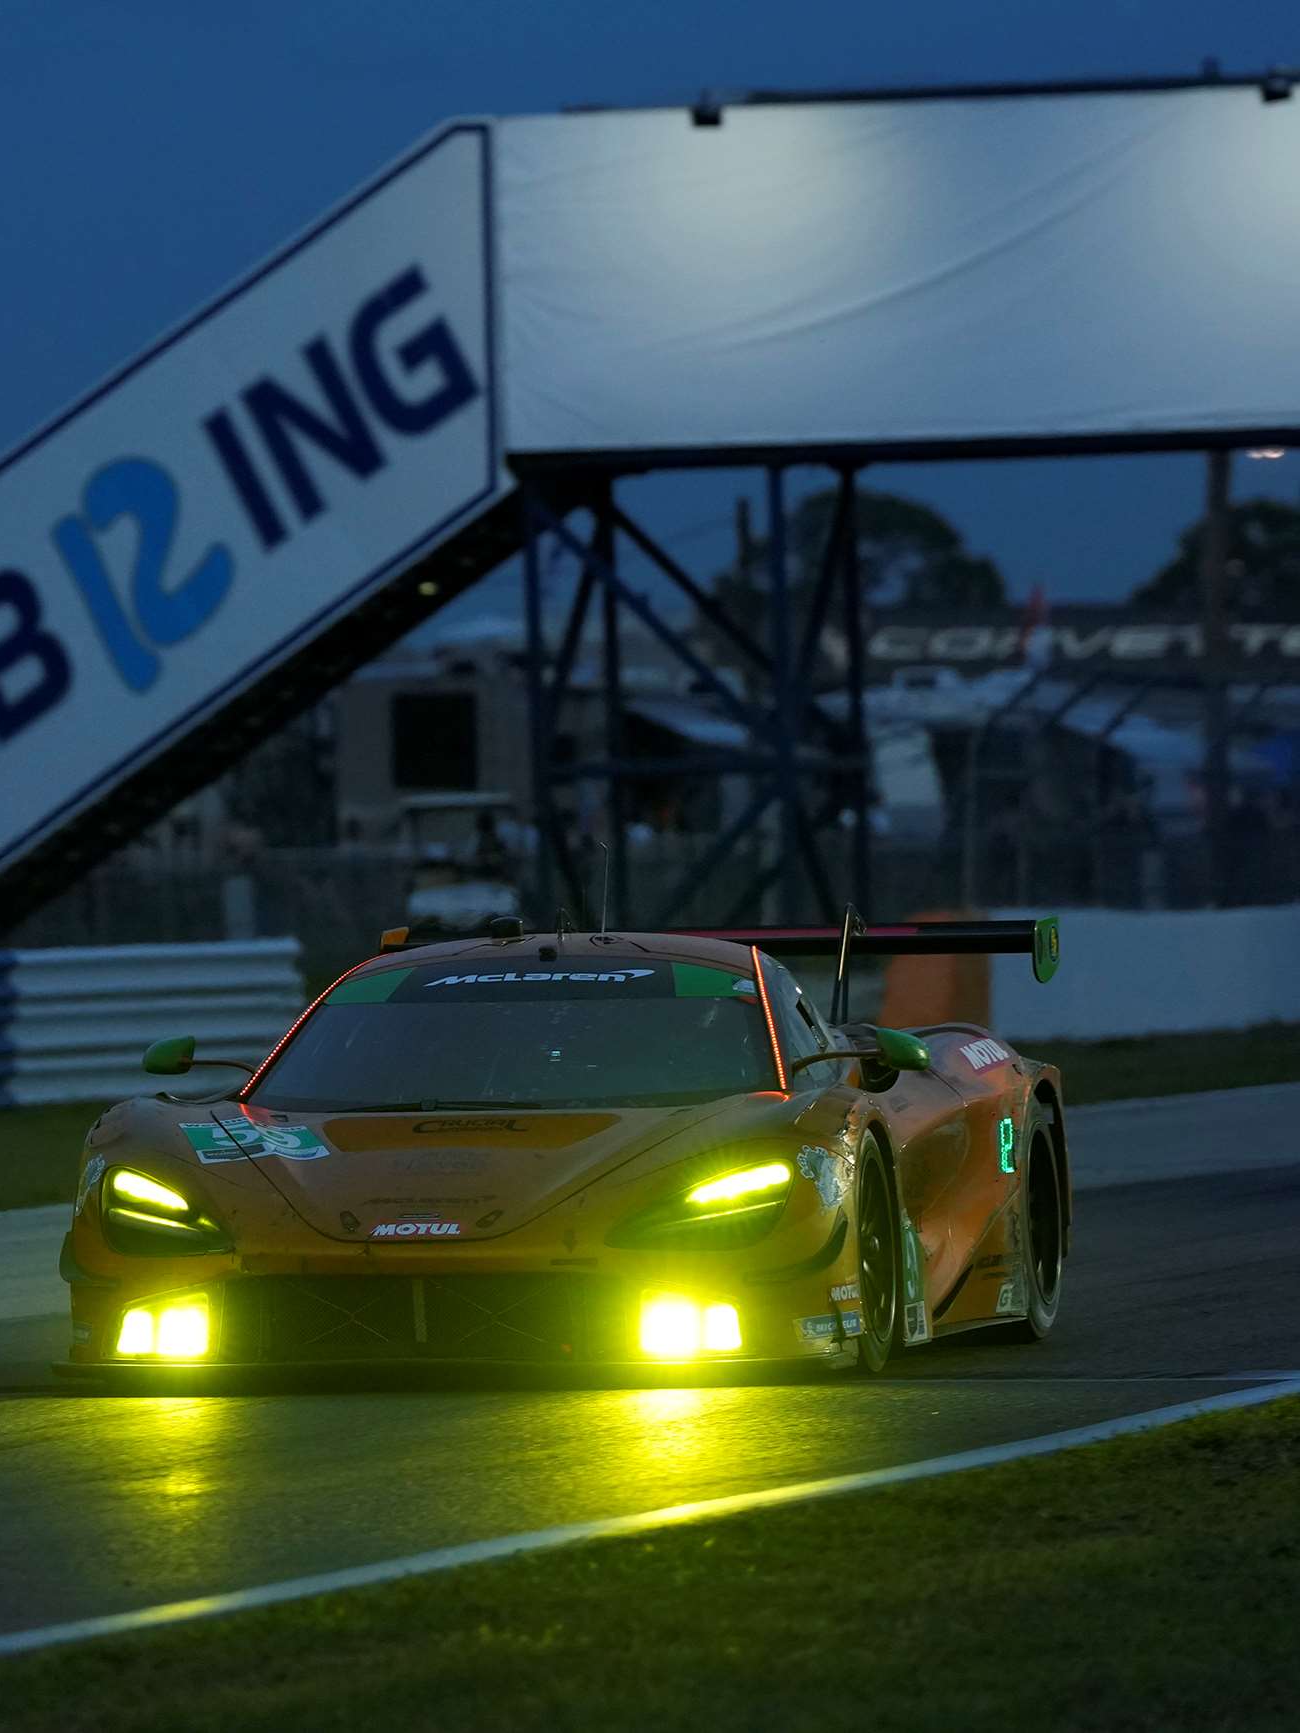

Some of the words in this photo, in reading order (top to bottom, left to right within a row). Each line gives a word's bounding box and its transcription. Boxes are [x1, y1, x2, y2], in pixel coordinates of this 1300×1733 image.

[422, 968, 656, 987] McLaren
[959, 1038, 1011, 1070] MOTUL
[369, 1223, 461, 1236] MOTUL
